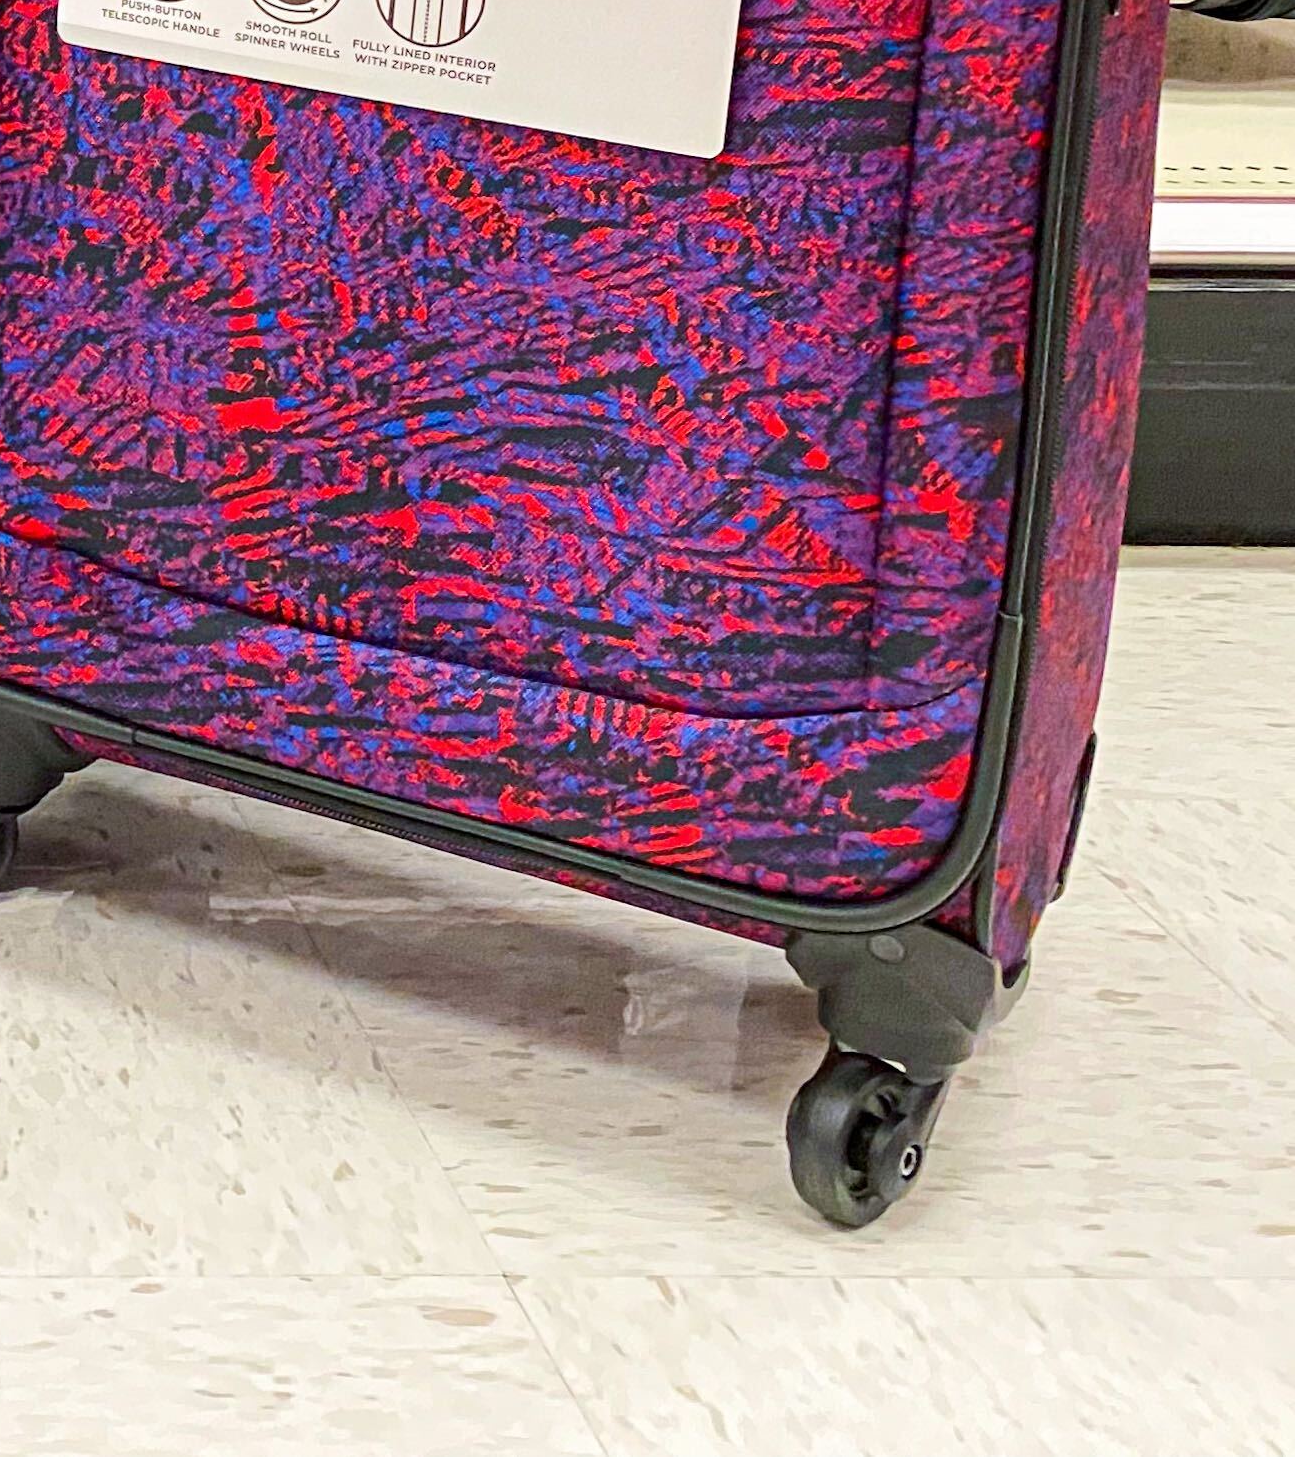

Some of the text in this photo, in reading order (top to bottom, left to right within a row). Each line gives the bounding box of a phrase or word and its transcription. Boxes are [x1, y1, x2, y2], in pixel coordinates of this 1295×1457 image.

[102, 8, 220, 38] TELESCOPIC HANDLE
[245, 21, 332, 44] SMOOTH ROLL
[235, 32, 340, 59] SPINNER WHEELS
[352, 39, 496, 72] FULLY LINED INTERIOR
[354, 53, 492, 85] WITH ZIPPER POCKET
